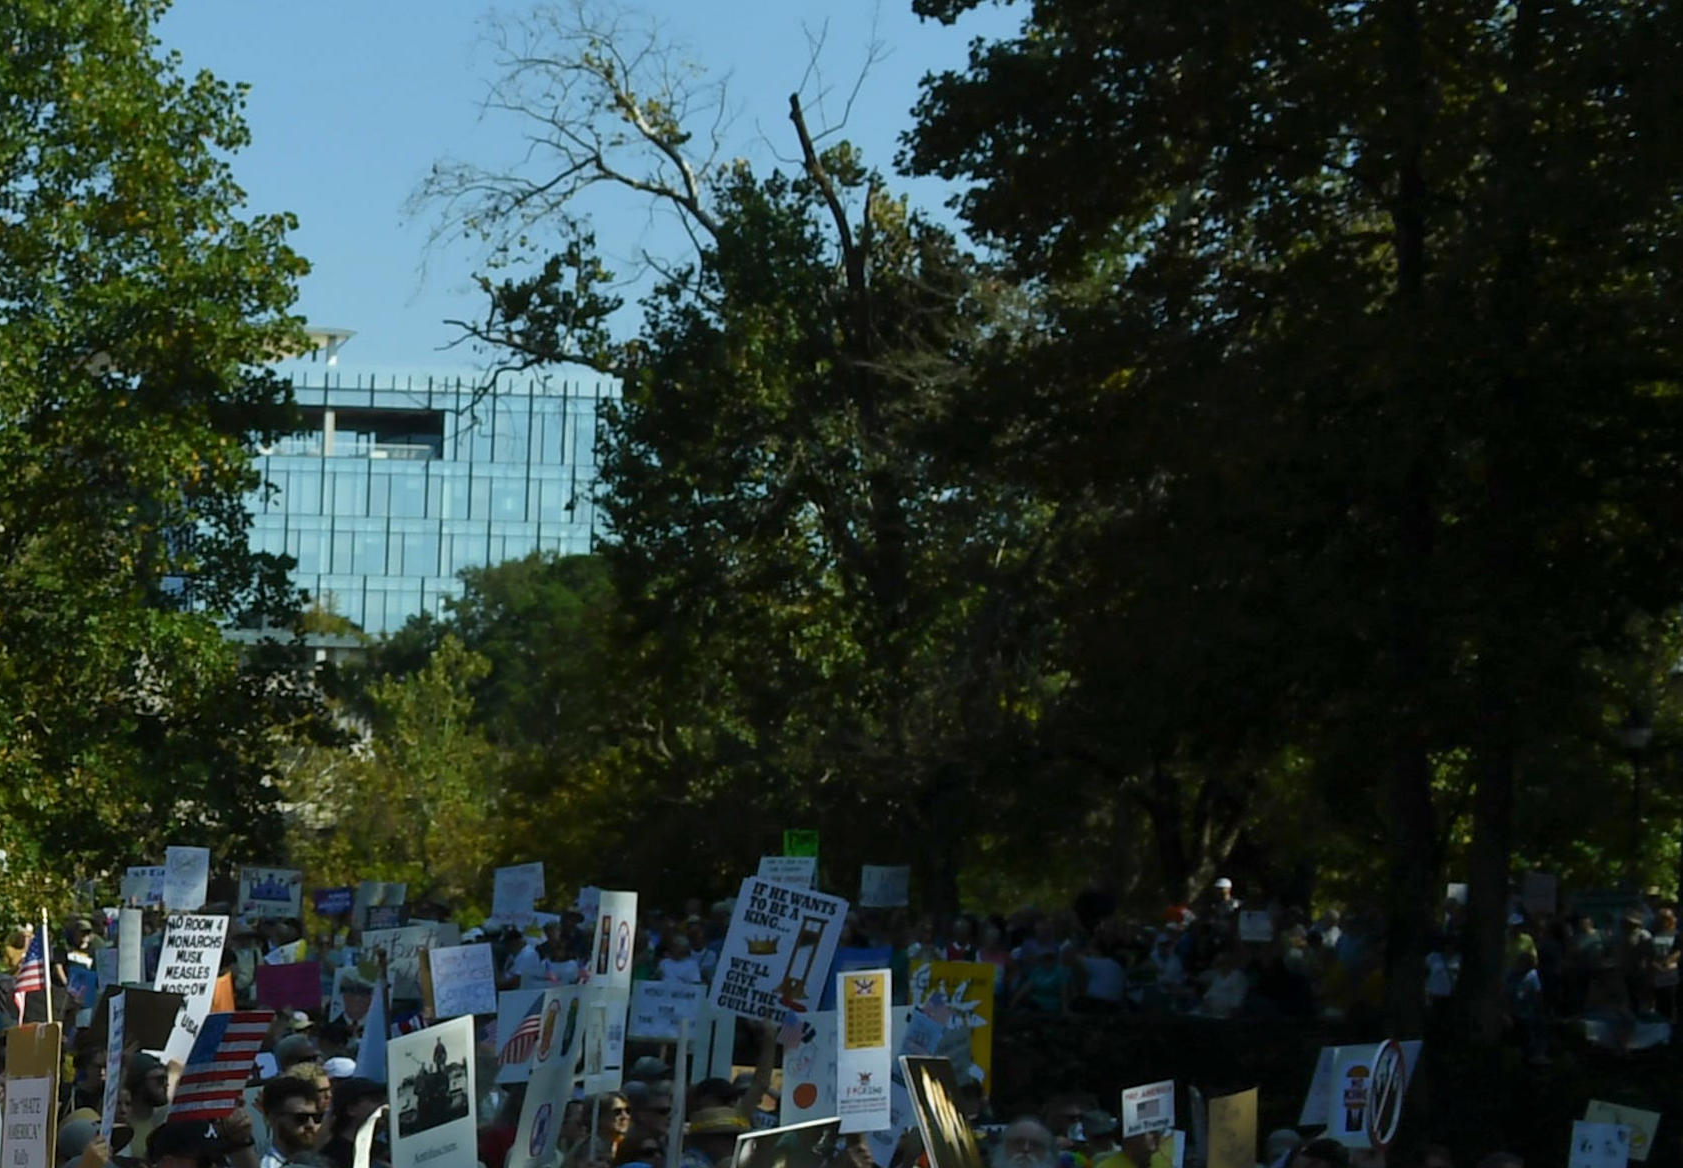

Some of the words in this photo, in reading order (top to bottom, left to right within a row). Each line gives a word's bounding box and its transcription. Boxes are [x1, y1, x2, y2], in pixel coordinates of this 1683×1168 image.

[750, 895, 768, 912] TO
[769, 901, 789, 918] BE
[789, 908, 800, 921] A
[752, 881, 768, 895] IF
[769, 885, 789, 902] HE
[790, 890, 839, 917] WANTS
[167, 915, 184, 934] NO
[184, 917, 214, 932] ROOM
[217, 918, 223, 931] 4
[166, 933, 223, 949] MONARCHS
[175, 949, 204, 965] MUSK
[730, 956, 771, 978] WE'LL
[164, 965, 211, 980] MEASLES
[726, 969, 758, 988] GIVE
[161, 982, 209, 998] MOSCOW
[721, 981, 749, 1000] HIM
[750, 989, 779, 1007] THE
[717, 995, 786, 1023] GUILLOTI
[180, 1015, 199, 1039] USA
